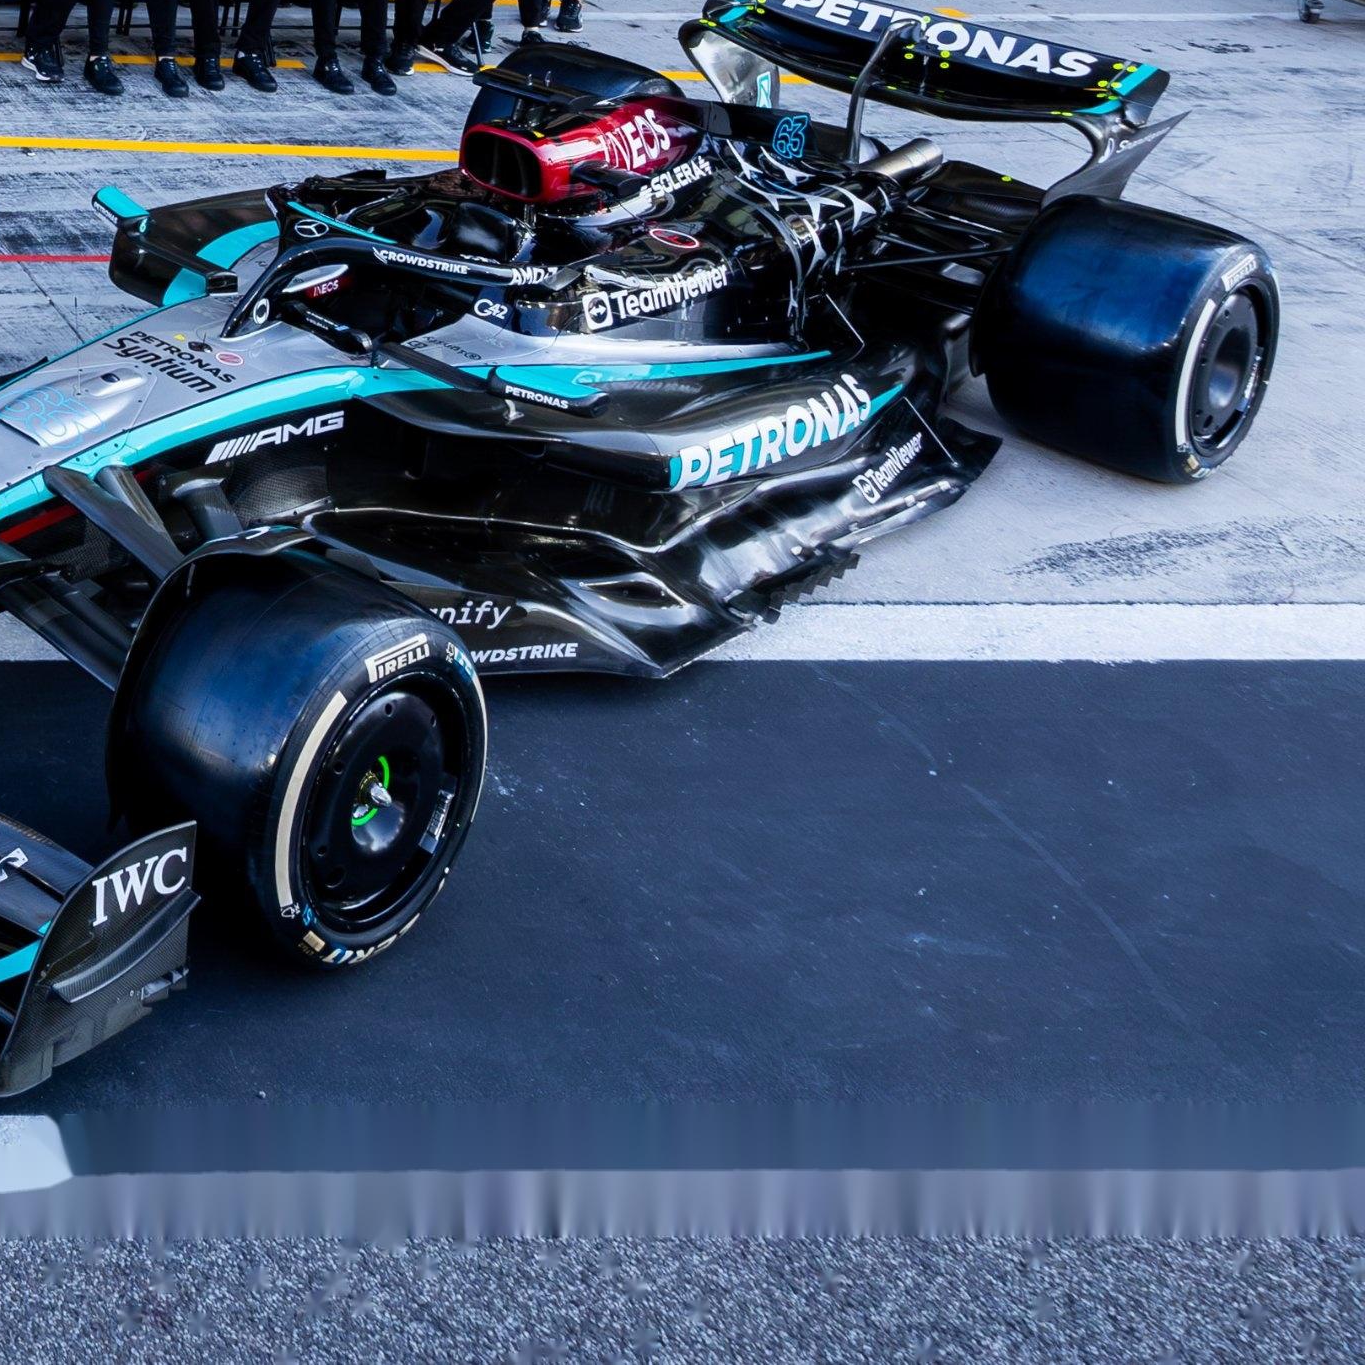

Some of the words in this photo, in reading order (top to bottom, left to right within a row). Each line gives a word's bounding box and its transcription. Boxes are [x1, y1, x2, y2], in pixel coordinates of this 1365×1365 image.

[597, 110, 672, 171] INEOS
[773, 113, 810, 158] 63
[651, 160, 700, 198] SOLERA
[379, 250, 469, 275] CROWDSTRIKE
[314, 280, 339, 297] INEOS
[474, 298, 508, 319] G42
[610, 265, 729, 320] TeamViewer
[102, 337, 218, 394] Syntium
[129, 329, 236, 383] PETRONAS
[505, 385, 569, 410] PETRONAS
[252, 411, 345, 452] AMG
[674, 373, 872, 488] PETRONAS
[869, 434, 922, 498] TeamViewer
[365, 633, 429, 683] PIRELLI
[92, 846, 187, 926] IWC
